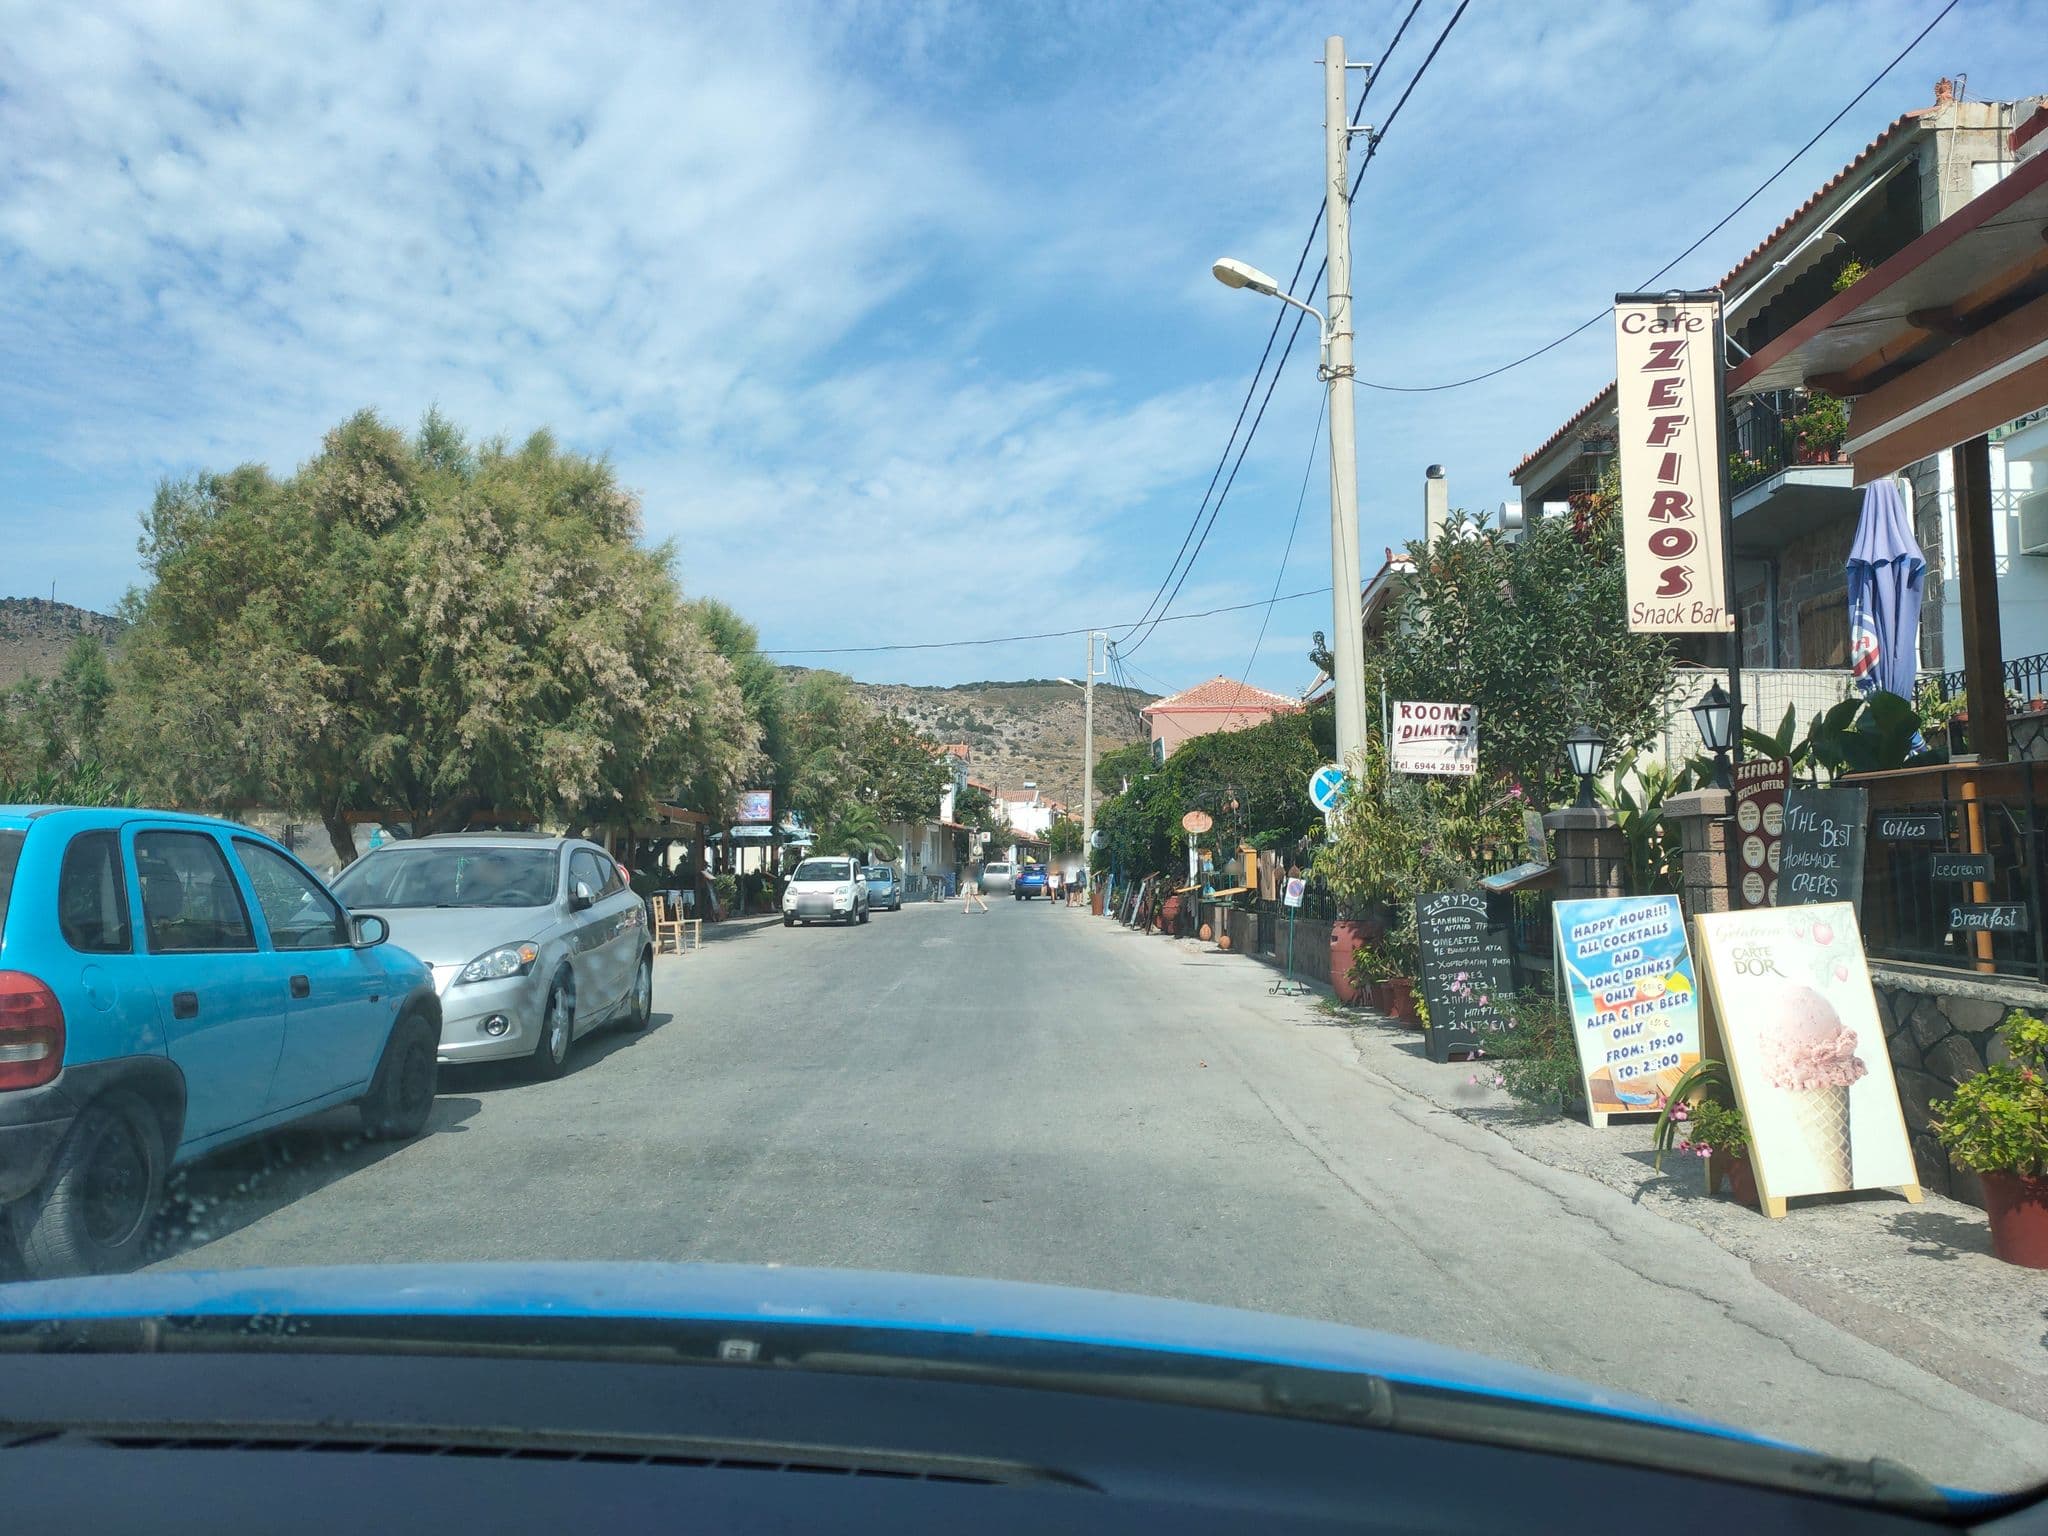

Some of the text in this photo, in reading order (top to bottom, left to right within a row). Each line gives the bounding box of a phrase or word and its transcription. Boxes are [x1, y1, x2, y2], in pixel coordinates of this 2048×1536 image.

[1621, 312, 1705, 335] Cafe
[1640, 339, 1699, 600] ZEFIROS
[1632, 601, 1724, 626] Snack Bar
[1401, 705, 1472, 721] ROOMS
[1414, 761, 1437, 770] 6944
[1440, 763, 1456, 771] 289
[1460, 764, 1475, 772] 591
[1738, 760, 1784, 780] ZEFIROS
[1737, 780, 1785, 802] SPECIAL OFFERS
[1789, 805, 1818, 833] THE
[1820, 819, 1855, 848] BEST
[1882, 820, 1926, 839] Coffees
[1783, 844, 1841, 869] HOMEMADE
[1931, 857, 1985, 877] Icecream
[1791, 873, 1838, 897] CREPES
[1574, 905, 1668, 938] HAPPY HOUR!!!
[1951, 907, 2017, 929] Breakfast
[1579, 922, 1669, 956] ALL COCKTAILS
[1614, 949, 1641, 965] AND
[1731, 946, 1773, 960] CARTE
[1589, 972, 1620, 990] LONG
[1625, 960, 1672, 981] DRINKS
[1605, 986, 1636, 1004] ONLY
[1587, 1010, 1616, 1029] ALFA
[1634, 1001, 1654, 1016] FIX
[1659, 992, 1689, 1010] BEER
[1612, 1022, 1643, 1039] ONLY
[1606, 1032, 1684, 1064] FROM: 19:00
[1618, 1064, 1638, 1080] TO:
